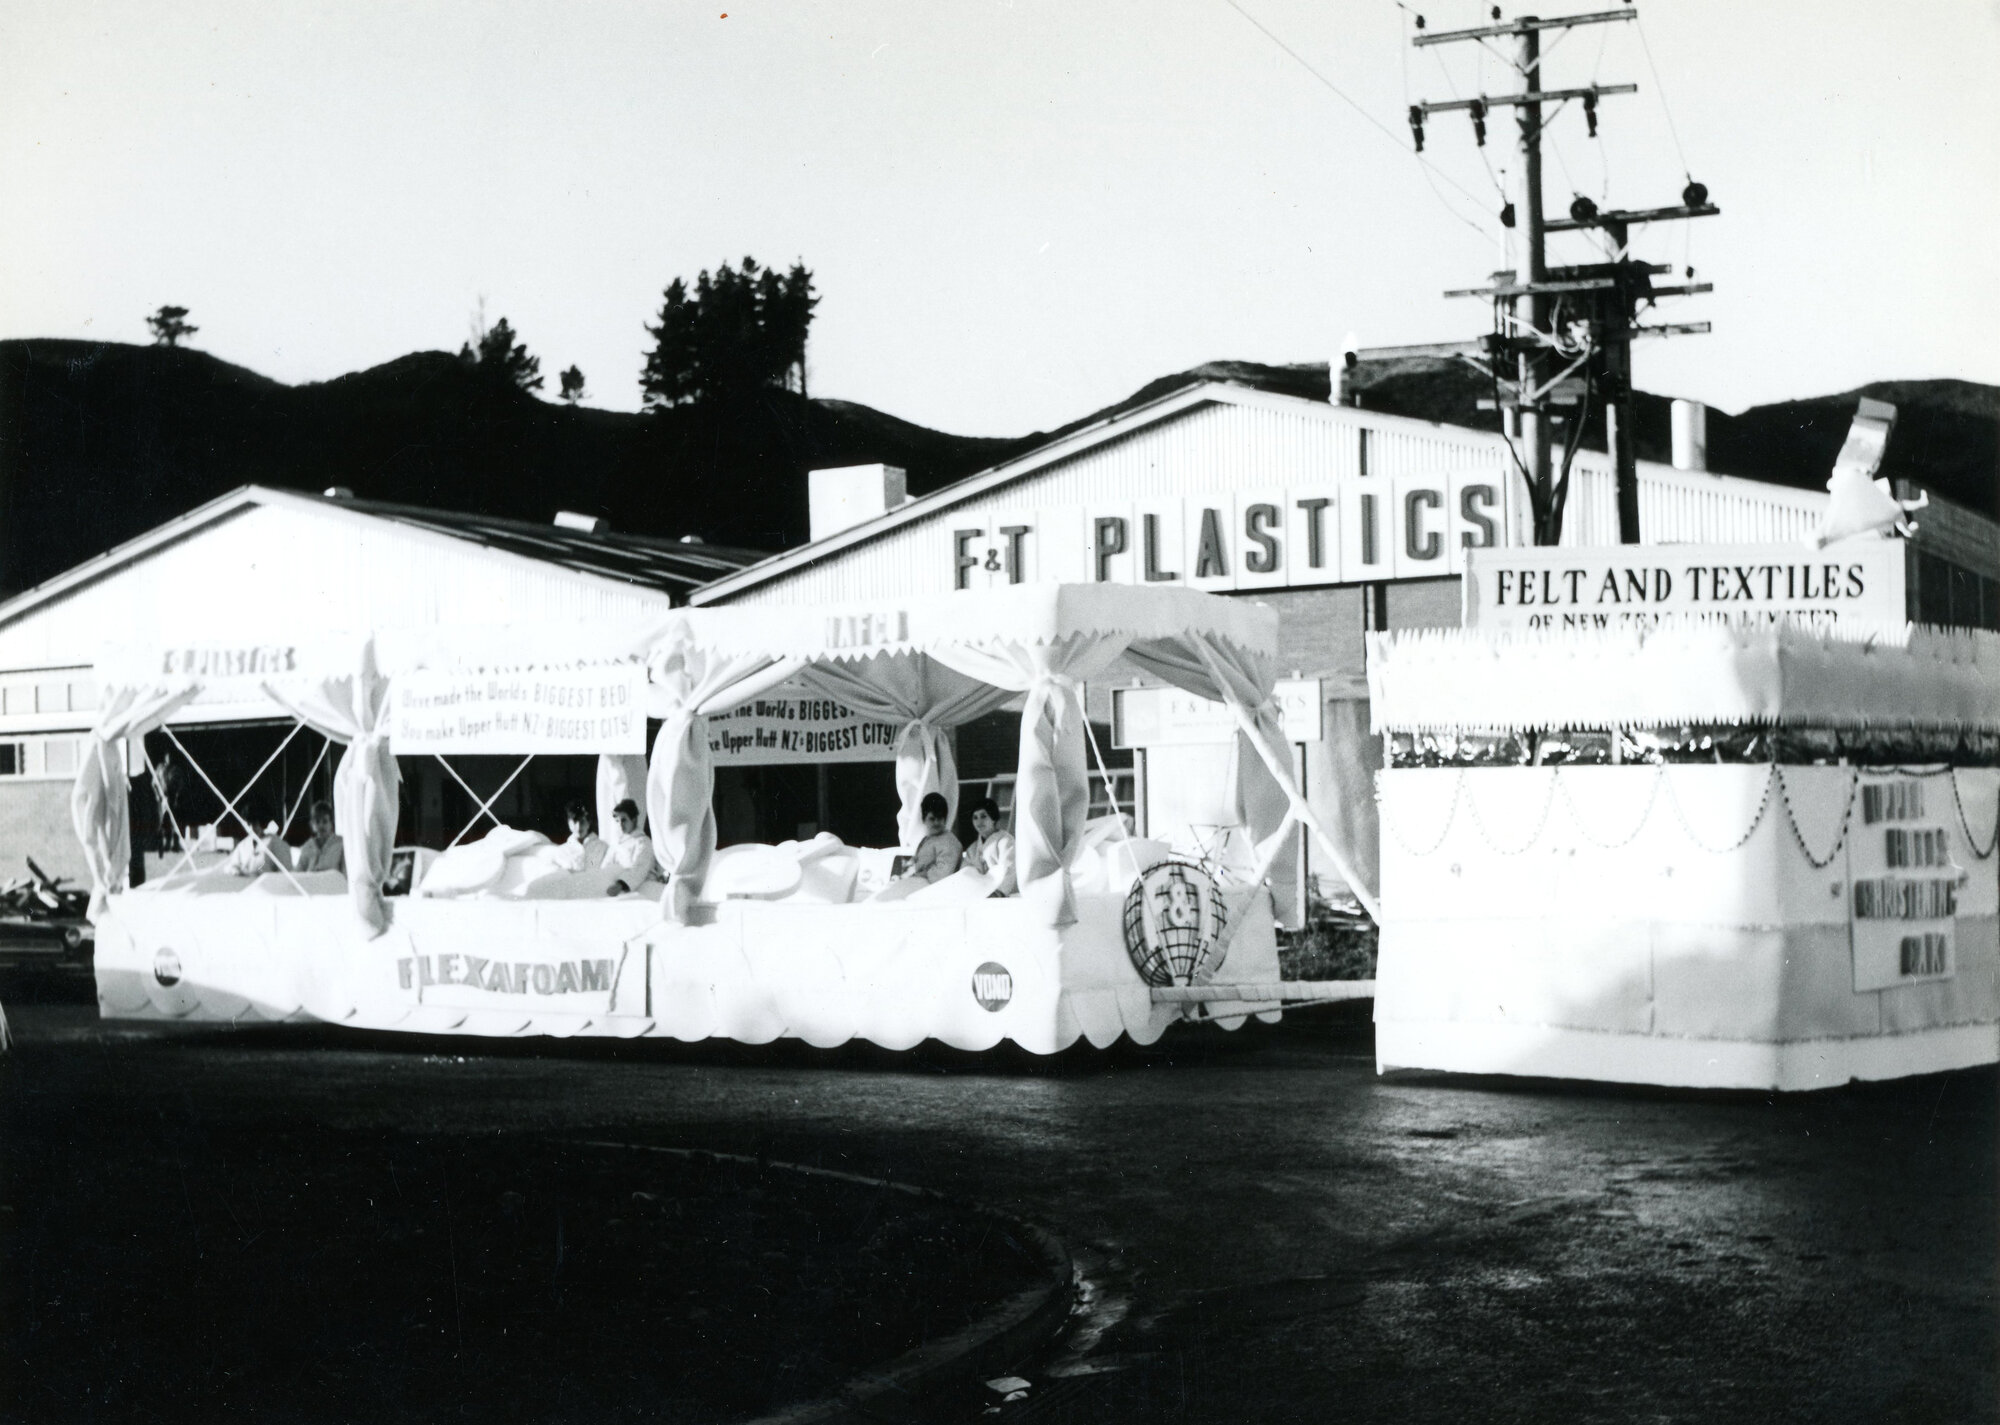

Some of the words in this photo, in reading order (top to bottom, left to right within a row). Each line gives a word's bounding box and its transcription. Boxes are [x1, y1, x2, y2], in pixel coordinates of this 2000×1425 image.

[1095, 484, 1498, 583] PLASTICS
[1496, 569, 1587, 606] FELT
[1597, 567, 1672, 604] AND
[1685, 564, 1866, 602] TEXTILES
[1529, 613, 1553, 631] OF
[1563, 612, 1609, 631] NEW
[433, 684, 461, 708] made
[465, 682, 482, 703] the
[534, 681, 594, 709] BIGGEST
[599, 677, 633, 709] BED!
[425, 718, 455, 741] make
[459, 715, 492, 739] Upper
[496, 711, 518, 732] Hutt
[546, 716, 597, 741] BIGGEST
[600, 710, 634, 740] CITY!
[799, 699, 856, 721] BIGGES
[722, 729, 754, 755] Upper
[756, 726, 778, 748] Hutt
[806, 725, 858, 753] BIGGEST
[862, 722, 899, 752] CITY!
[398, 953, 614, 995] FLEXAFOAM
